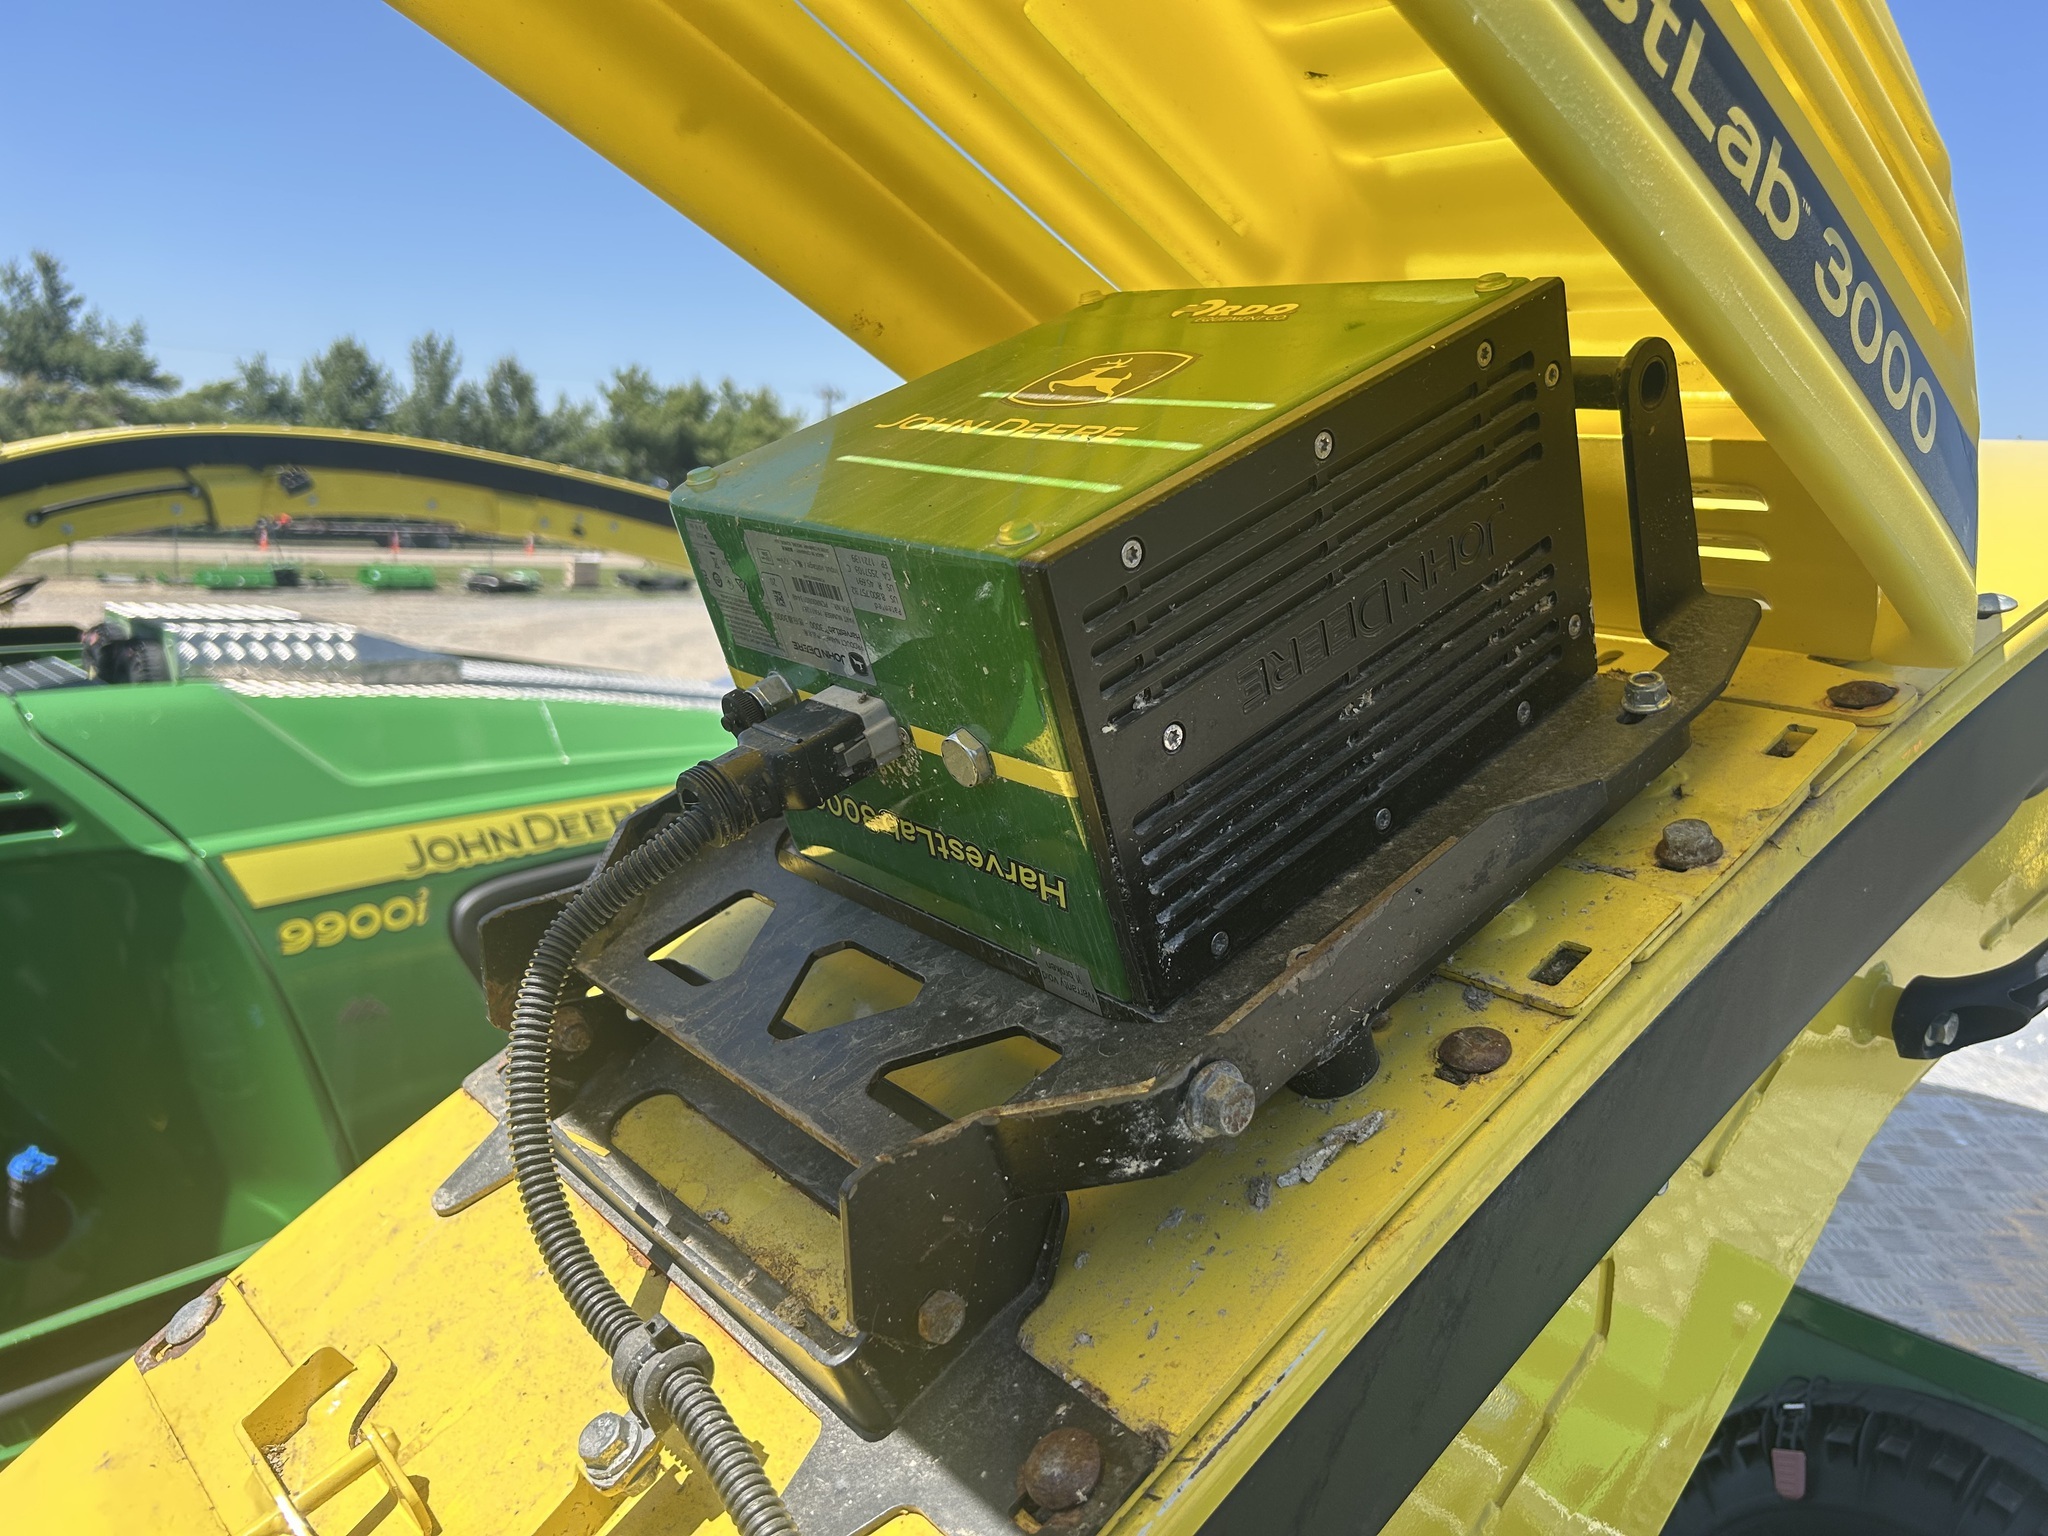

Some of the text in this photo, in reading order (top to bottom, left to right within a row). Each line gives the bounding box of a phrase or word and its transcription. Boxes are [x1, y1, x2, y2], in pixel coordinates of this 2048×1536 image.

[1814, 227, 1937, 454] 3000
[874, 413, 1139, 444] JOHN DEERE
[882, 572, 891, 581] CA
[886, 584, 895, 592] US
[874, 603, 902, 615] Patented
[890, 595, 898, 604] US
[1236, 502, 1505, 715] JOHN DEERE
[792, 640, 846, 665] JOHN DEERE
[817, 795, 884, 826] 300
[406, 797, 650, 873] JOHN DEER
[278, 886, 430, 956] 9900i
